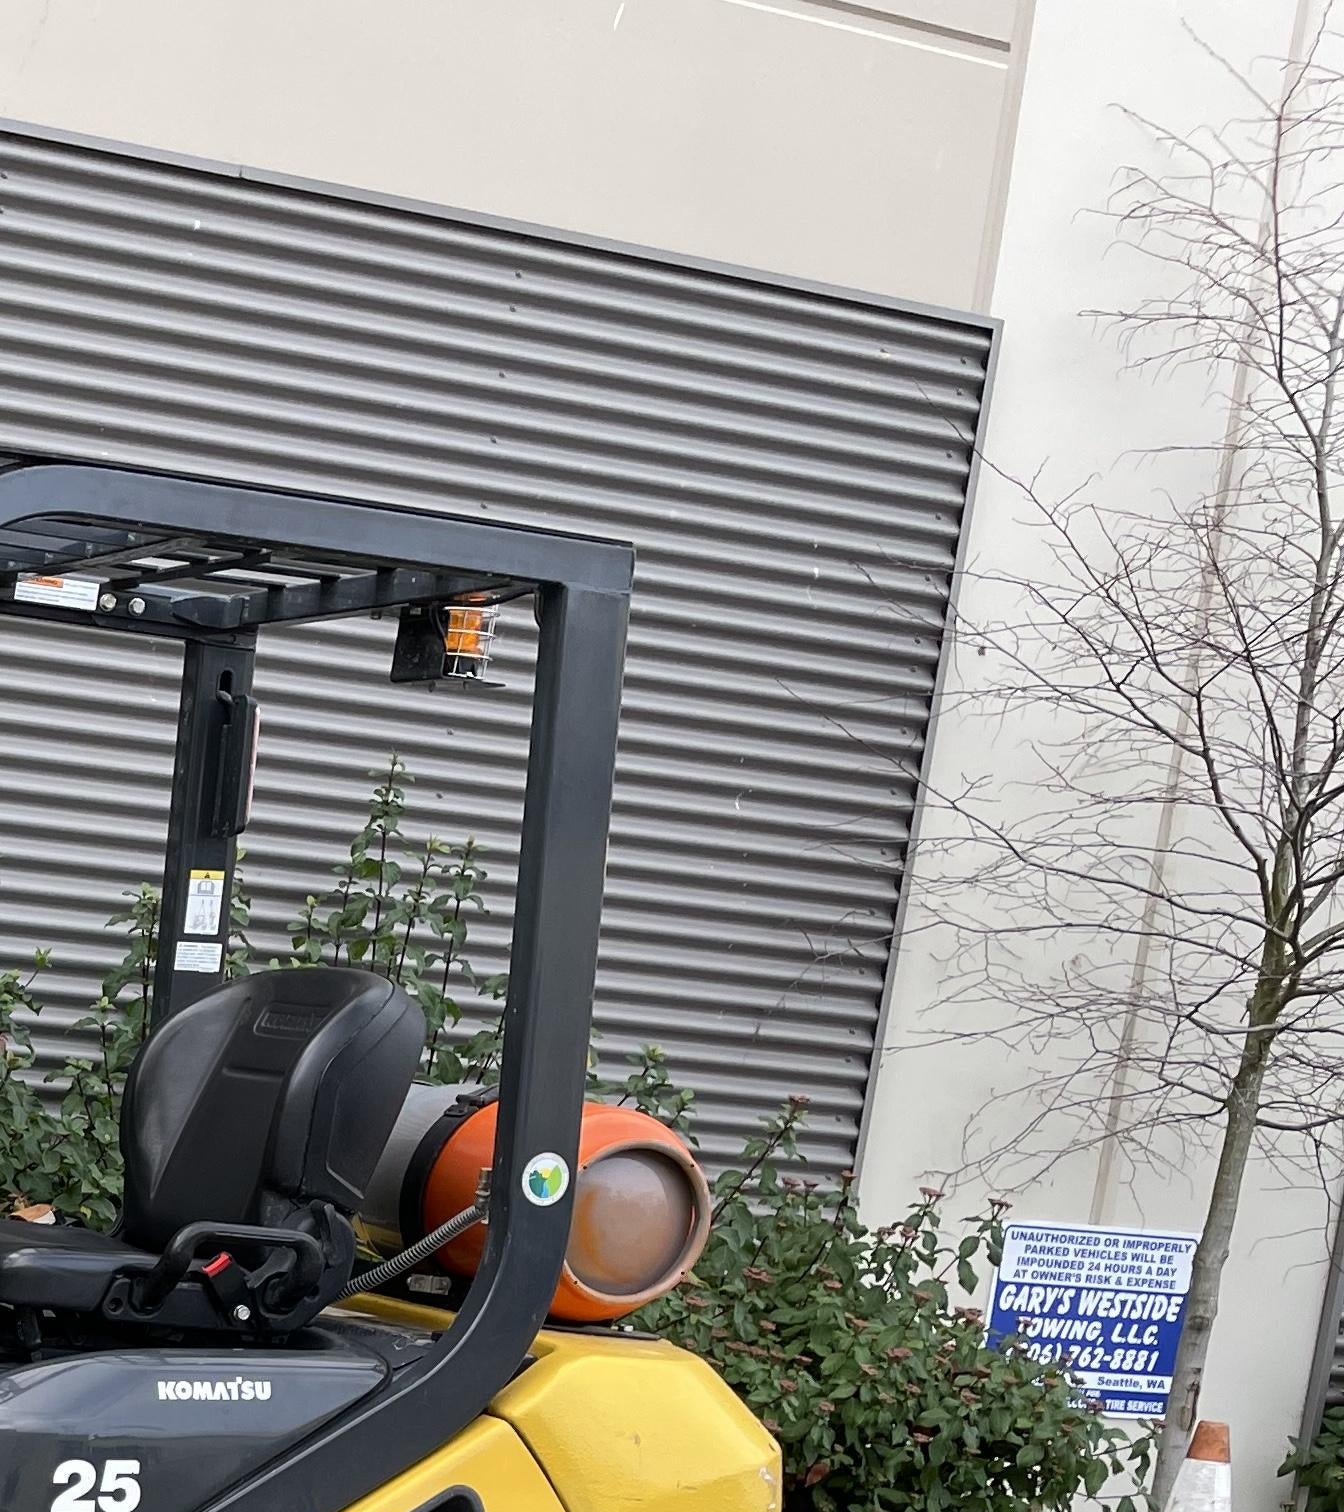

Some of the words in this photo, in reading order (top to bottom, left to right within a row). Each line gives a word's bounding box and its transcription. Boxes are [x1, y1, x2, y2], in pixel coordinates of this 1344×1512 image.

[1011, 1231, 1100, 1247] UNAUTHORIZED
[1104, 1238, 1119, 1248] OR
[1123, 1239, 1192, 1254] IMPROPERLY
[1024, 1244, 1070, 1257] PARKED
[1073, 1249, 1127, 1261] VEHICLES
[1131, 1252, 1157, 1264] WILL
[1160, 1254, 1174, 1265] BE
[1016, 1256, 1085, 1270] IMPOUNDED
[1087, 1262, 1101, 1272] 24
[1104, 1263, 1142, 1274] HOURS
[1145, 1266, 1153, 1275] A
[1156, 1267, 1177, 1277] DAY
[1013, 1269, 1028, 1279] AT
[1031, 1270, 1082, 1283] OWNER'S
[1085, 1274, 1111, 1285] RISK
[1115, 1276, 1123, 1286] &
[1126, 1277, 1177, 1290] EXPENSE
[999, 1285, 1074, 1315] GARY'S
[1077, 1290, 1184, 1323] WESTSIDE
[1111, 1322, 1159, 1346] L.L.C.
[1066, 1347, 1160, 1372] 762-8881
[157, 1377, 272, 1401] KOMATSU
[1097, 1376, 1143, 1390] Seattle,
[1146, 1380, 1166, 1390] WA
[1105, 1399, 1126, 1411] TIRE
[1126, 1400, 1164, 1413] SERVICE
